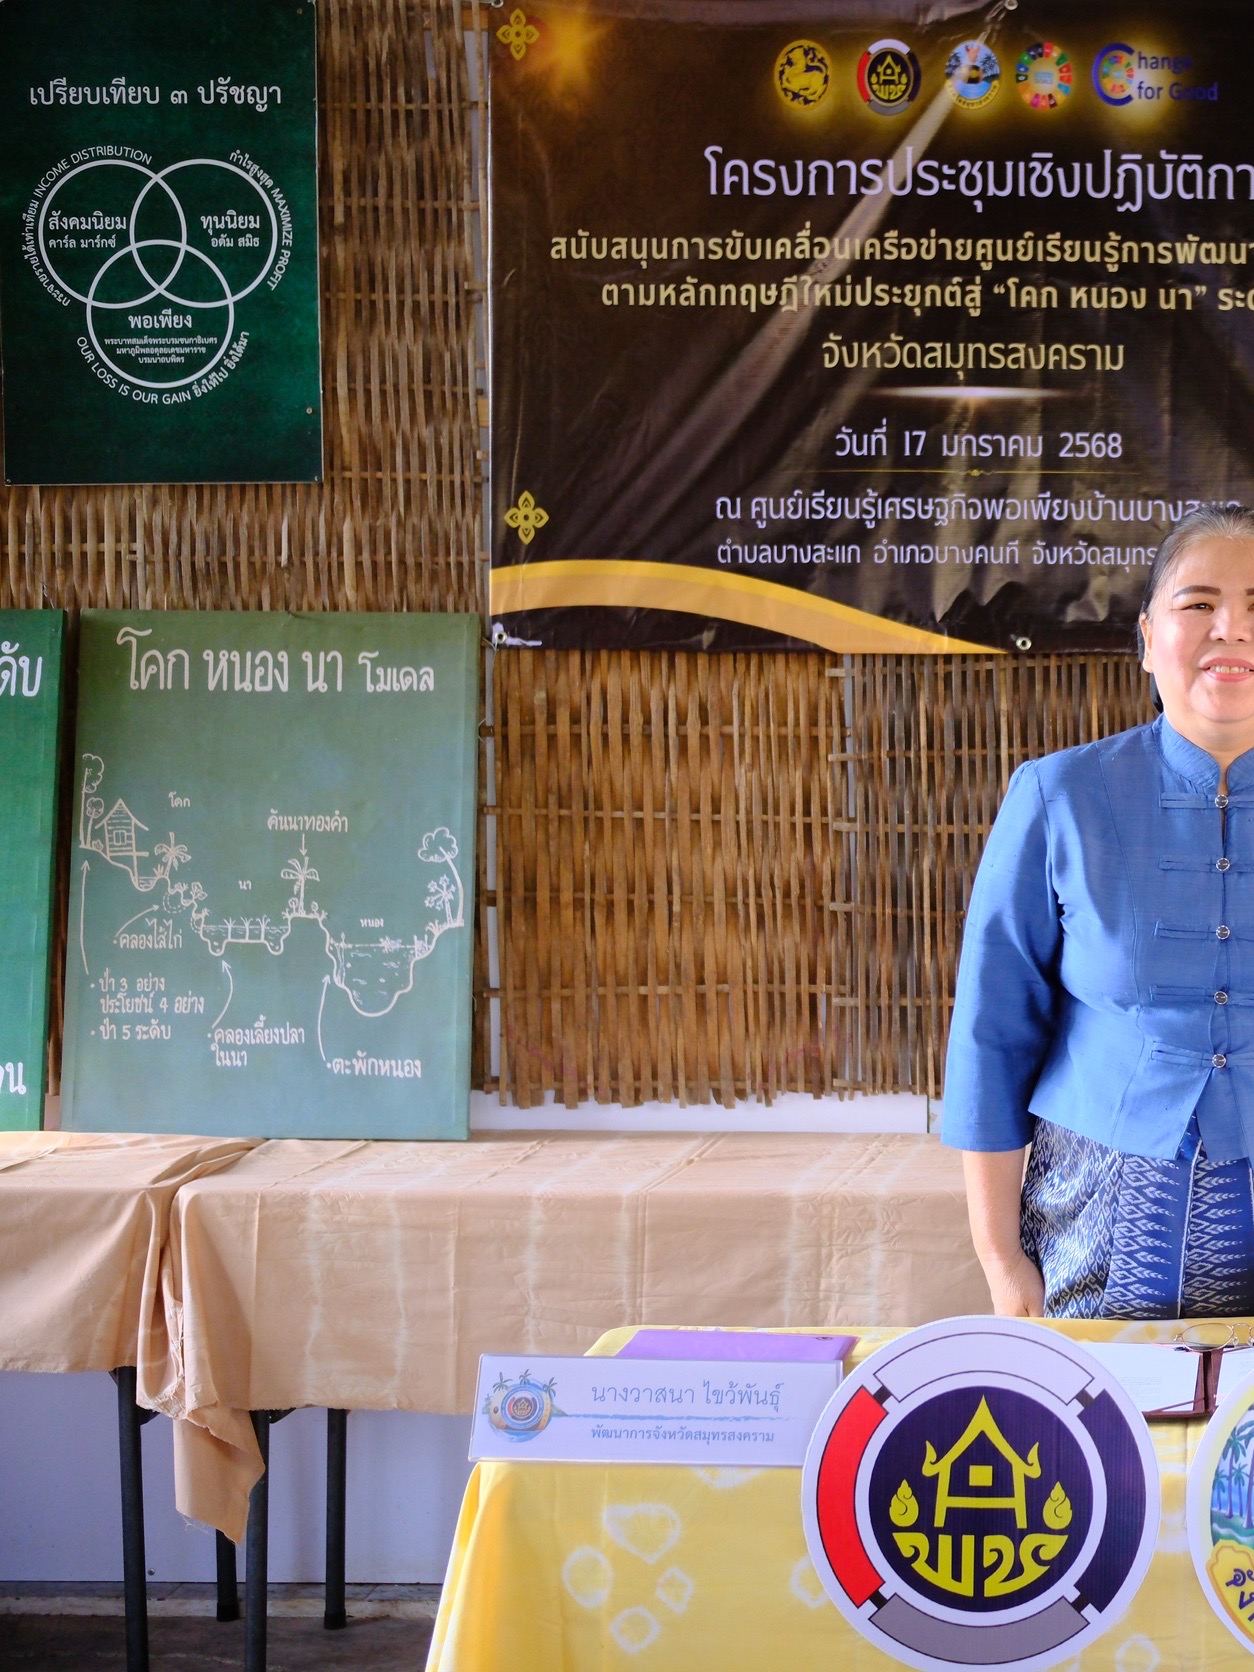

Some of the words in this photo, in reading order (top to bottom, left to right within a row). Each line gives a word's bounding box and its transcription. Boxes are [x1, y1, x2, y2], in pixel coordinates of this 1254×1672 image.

[30, 77, 160, 105] เปรียบเทียบ
[170, 90, 188, 104] ๓
[197, 76, 282, 113] ปรัชญา
[1137, 82, 1163, 100] for
[1169, 82, 1219, 101] Good
[33, 158, 71, 199] INCOME
[70, 145, 152, 166] DISTRIBUTION
[229, 149, 274, 190] กำไรสูงสุด
[48, 210, 127, 230] สังคมนิยม
[200, 210, 260, 235] ทุนนิยม
[270, 187, 293, 248] MAXIMIZE
[267, 249, 291, 291] PROFIT
[601, 275, 982, 317] ตามหลักทฤษฎีใหม่ประยุกต์สู่
[1070, 285, 1147, 310] หนอง
[128, 310, 192, 329] พอเพียง
[76, 336, 95, 359] OUR
[91, 360, 118, 389] LOSS
[118, 384, 131, 397] IS
[132, 391, 159, 405] OUR
[162, 390, 192, 406] GAIN
[822, 332, 1125, 380] จังหวัดสมุทรสงคราม
[835, 417, 888, 458] วันที่
[904, 432, 927, 457] 17
[941, 433, 1044, 458] มกราคม
[1058, 432, 1124, 459] 2568
[715, 497, 741, 521] ณ
[750, 488, 1240, 531] ศูนย์เรียนรู้เศรษฐกิจพอเพียงบ้านบางส
[717, 538, 862, 565] ตำบลบางสะแก
[873, 538, 1019, 565] อำเภอบางคนที
[1032, 539, 1158, 573] จังหวัดสมุทร
[116, 626, 191, 691] โคก
[202, 649, 291, 693] หนอง
[301, 649, 345, 694] นา
[357, 651, 436, 694] โมเดล
[168, 791, 192, 809] โคก
[238, 879, 252, 891] นา
[119, 917, 183, 949] คลองไส้ไก่
[359, 915, 385, 930] หนอง
[99, 967, 115, 992] ป่า
[119, 979, 128, 992] 3
[136, 973, 165, 992] อย่าง
[100, 991, 154, 1014] ประโยชน์
[159, 997, 168, 1014] 4
[174, 991, 205, 1014] อย่าง
[99, 1017, 116, 1040] ป่า
[122, 1025, 131, 1040] 5
[135, 1019, 171, 1040] ระดับ
[214, 1015, 305, 1045] คลองเลี้ยงปลา
[210, 1043, 248, 1067] ในนา
[332, 1051, 422, 1079] ตะพักหนอง
[592, 1385, 694, 1404] นางวาสนา
[703, 1380, 785, 1413] ไขว้พันธุ์
[591, 1426, 774, 1446] พัฒนาการจังหวัดสมุทรสงคราม
